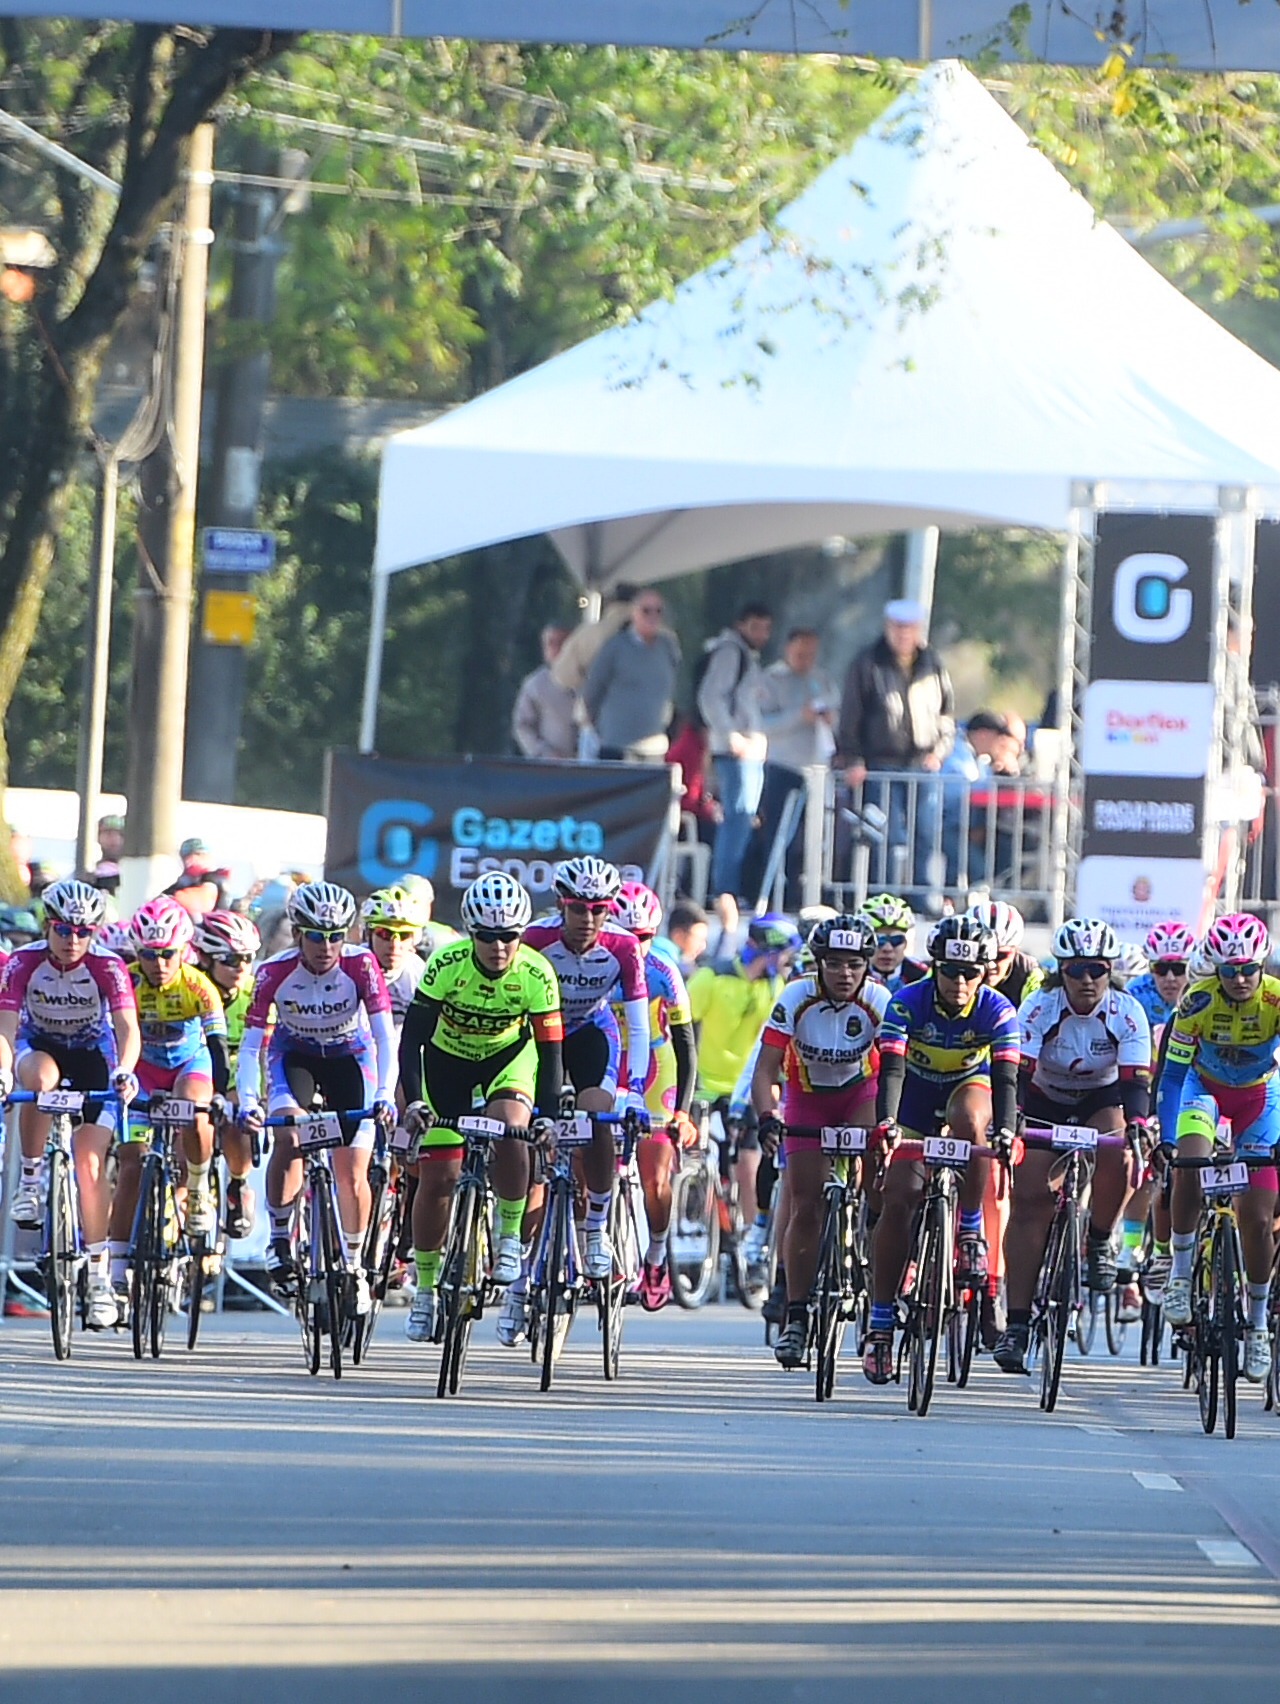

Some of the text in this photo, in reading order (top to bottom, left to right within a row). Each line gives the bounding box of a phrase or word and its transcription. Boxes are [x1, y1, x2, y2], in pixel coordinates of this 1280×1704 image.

[452, 806, 604, 852] Gazeta
[583, 876, 599, 890] 24
[491, 909, 507, 923] 11
[147, 926, 166, 940] 20
[836, 932, 854, 946] 10
[1083, 933, 1093, 948] 4
[951, 942, 971, 958] 39
[1164, 941, 1179, 953] 15
[1227, 942, 1245, 957] 21
[46, 992, 94, 1006] weber
[296, 999, 350, 1015] weber
[51, 1093, 69, 1107] 25
[162, 1101, 181, 1117] 20
[473, 1118, 490, 1130] 11
[560, 1122, 578, 1138] 24
[308, 1123, 328, 1141] 26
[1069, 1129, 1078, 1142] 4
[940, 1142, 956, 1157] 39
[1214, 1167, 1232, 1184] 21
